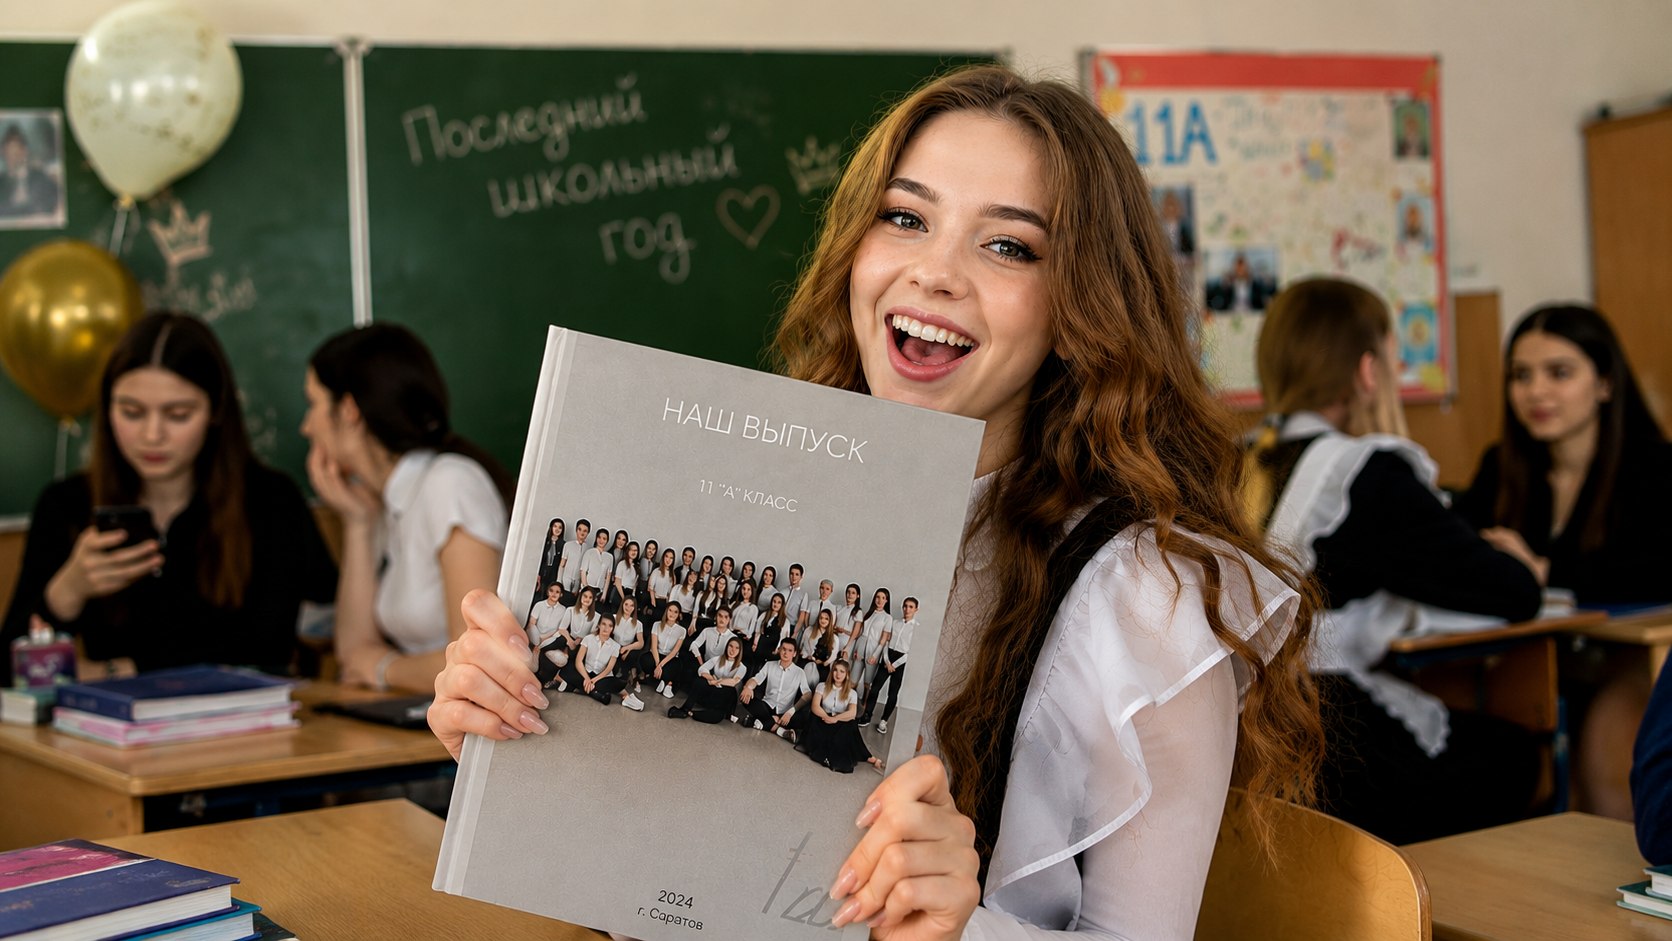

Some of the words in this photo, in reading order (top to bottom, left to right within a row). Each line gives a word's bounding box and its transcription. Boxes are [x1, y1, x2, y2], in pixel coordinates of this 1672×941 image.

[402, 71, 648, 166] Последний
[487, 122, 742, 218] школьный
[599, 211, 696, 285] год
[662, 397, 735, 435] НАШ
[742, 414, 868, 464] ВЫПУСК
[699, 479, 713, 495] 11
[743, 489, 798, 512] КЛАСС
[637, 905, 646, 917] г.
[649, 907, 704, 931] Саратов
[657, 889, 694, 909] 2024
